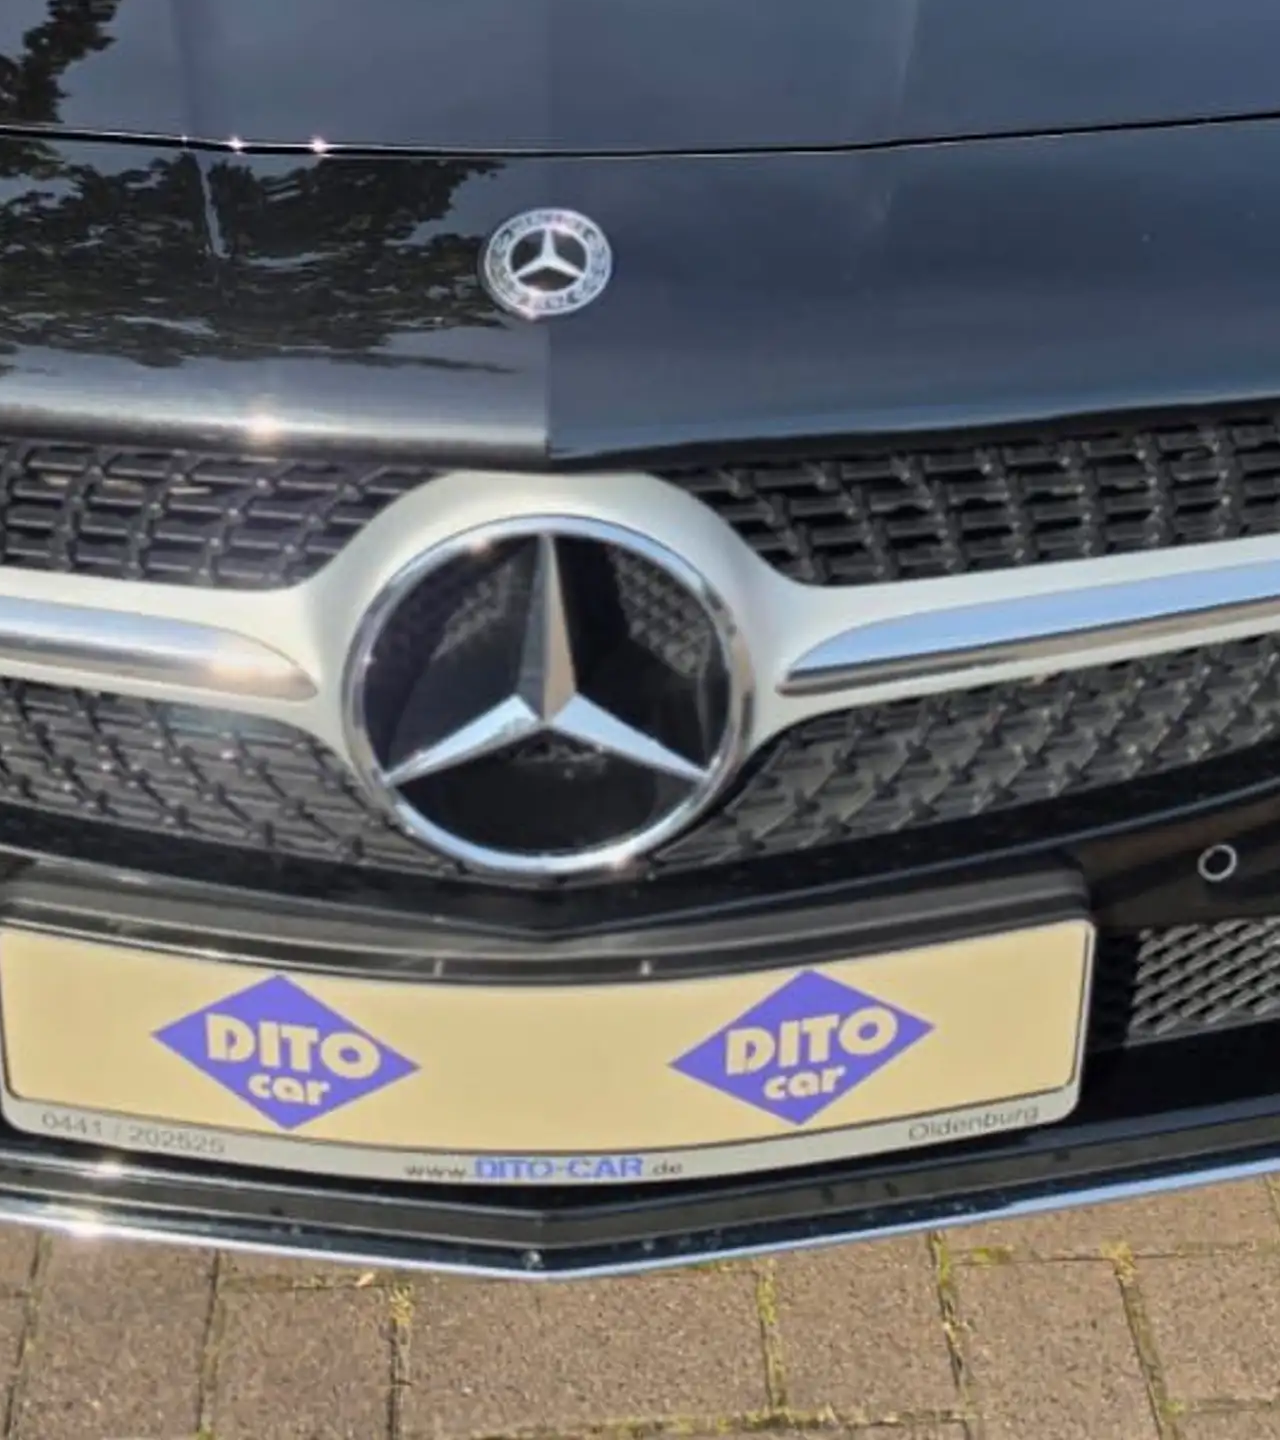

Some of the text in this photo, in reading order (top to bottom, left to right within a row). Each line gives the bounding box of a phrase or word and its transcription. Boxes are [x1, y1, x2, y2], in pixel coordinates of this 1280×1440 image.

[205, 1013, 381, 1080] DITO
[726, 1007, 898, 1076] DITO
[248, 1073, 331, 1107] car
[763, 1065, 846, 1101] car
[42, 1110, 102, 1136] 0441
[908, 1104, 1039, 1141] Oldenburg
